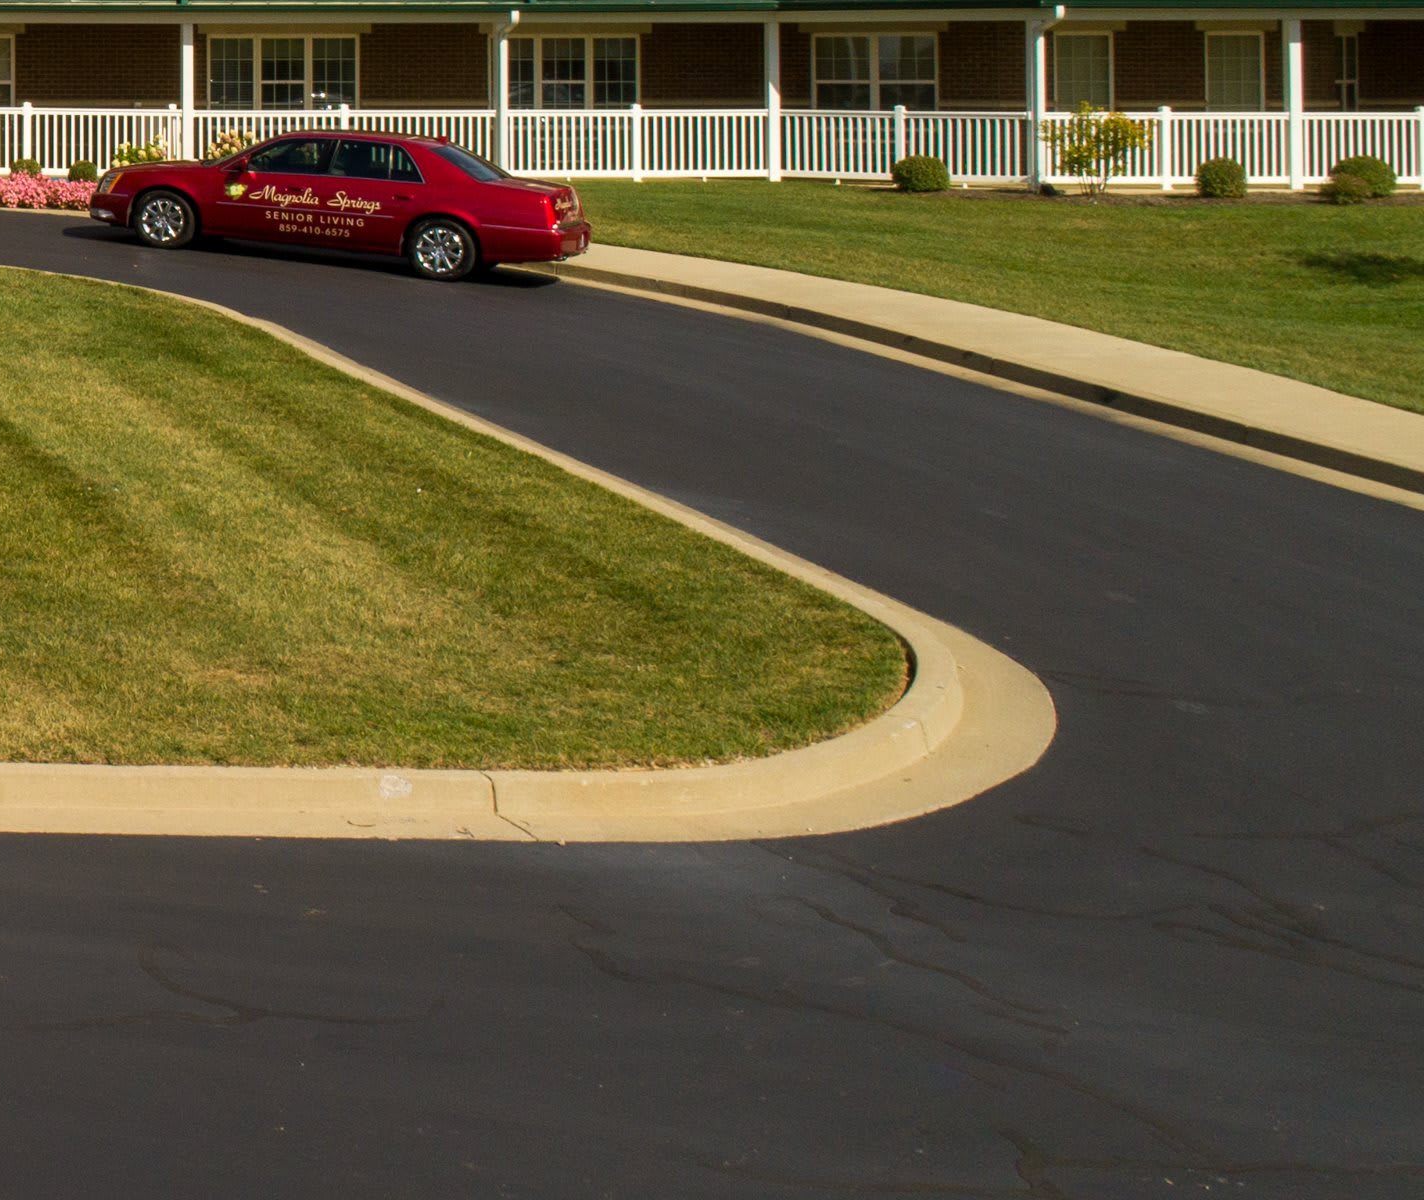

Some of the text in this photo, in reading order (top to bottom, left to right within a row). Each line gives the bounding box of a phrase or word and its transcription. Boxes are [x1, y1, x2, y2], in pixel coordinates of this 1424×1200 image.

[249, 185, 381, 214] Magnolia Springs
[265, 210, 364, 227] SENIOR LIVING
[279, 223, 350, 237] 859-410-6575
